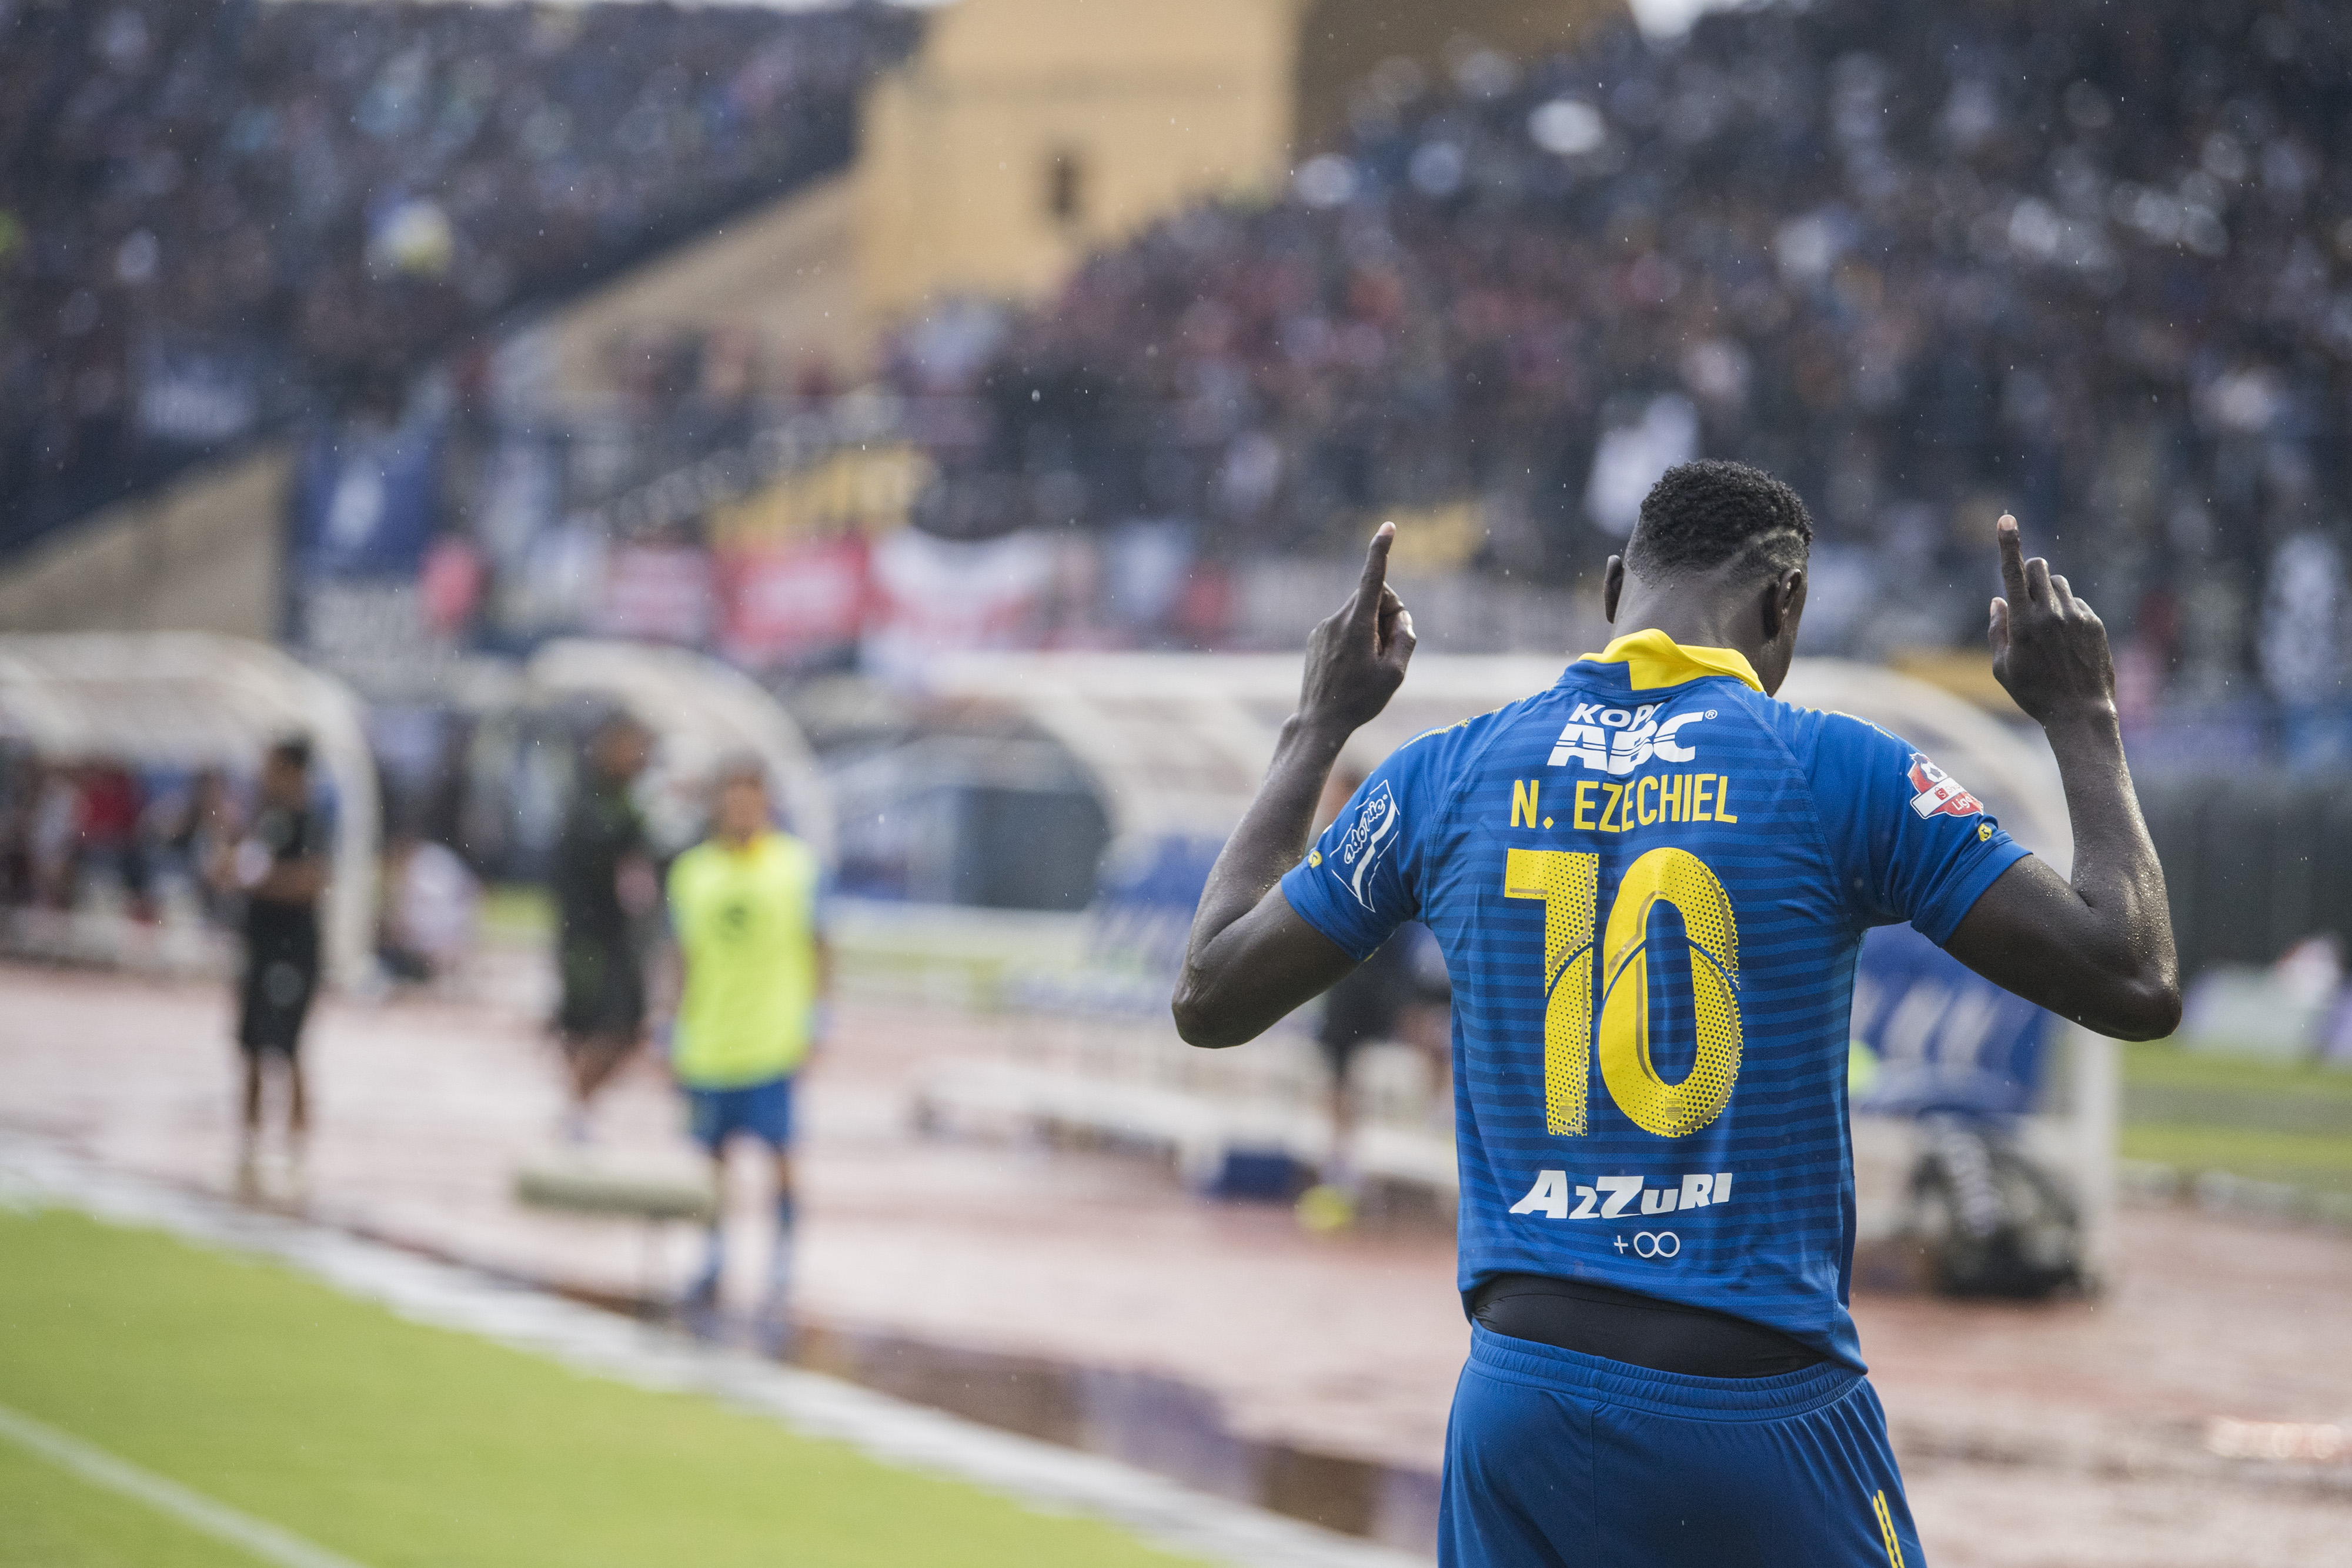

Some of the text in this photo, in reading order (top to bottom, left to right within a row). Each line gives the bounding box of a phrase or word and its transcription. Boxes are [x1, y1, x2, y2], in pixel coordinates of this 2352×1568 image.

[1511, 774, 1738, 833] N. EZECHIEL
[1505, 847, 1743, 1138] 10
